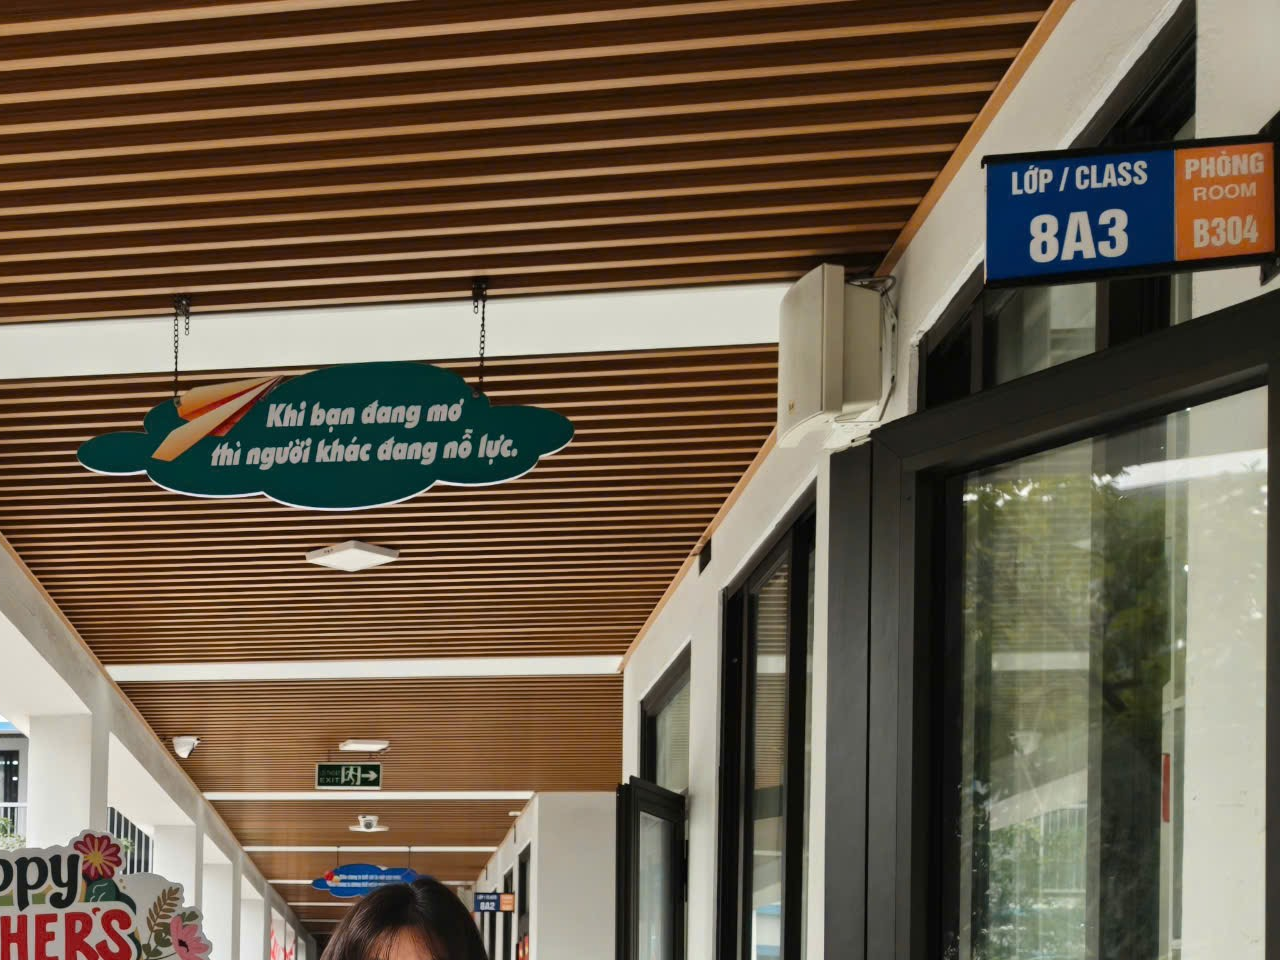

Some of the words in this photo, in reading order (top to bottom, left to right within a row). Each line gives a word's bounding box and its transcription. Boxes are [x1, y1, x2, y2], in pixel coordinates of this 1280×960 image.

[1011, 165, 1053, 195] LỚP
[1059, 166, 1069, 192] /
[1075, 160, 1148, 191] CLASS
[1185, 151, 1265, 180] PHÒNG
[1193, 182, 1257, 202] ROOM
[1029, 208, 1129, 264] 8A3
[1193, 215, 1259, 249] B304
[266, 401, 306, 428] Khi
[311, 402, 355, 433] bạn
[361, 399, 421, 426] đang
[426, 398, 464, 423] mơ
[211, 441, 241, 467] thì
[246, 436, 310, 471] người
[317, 436, 370, 464] khác
[376, 440, 437, 466] đang
[442, 428, 472, 460] nỗ
